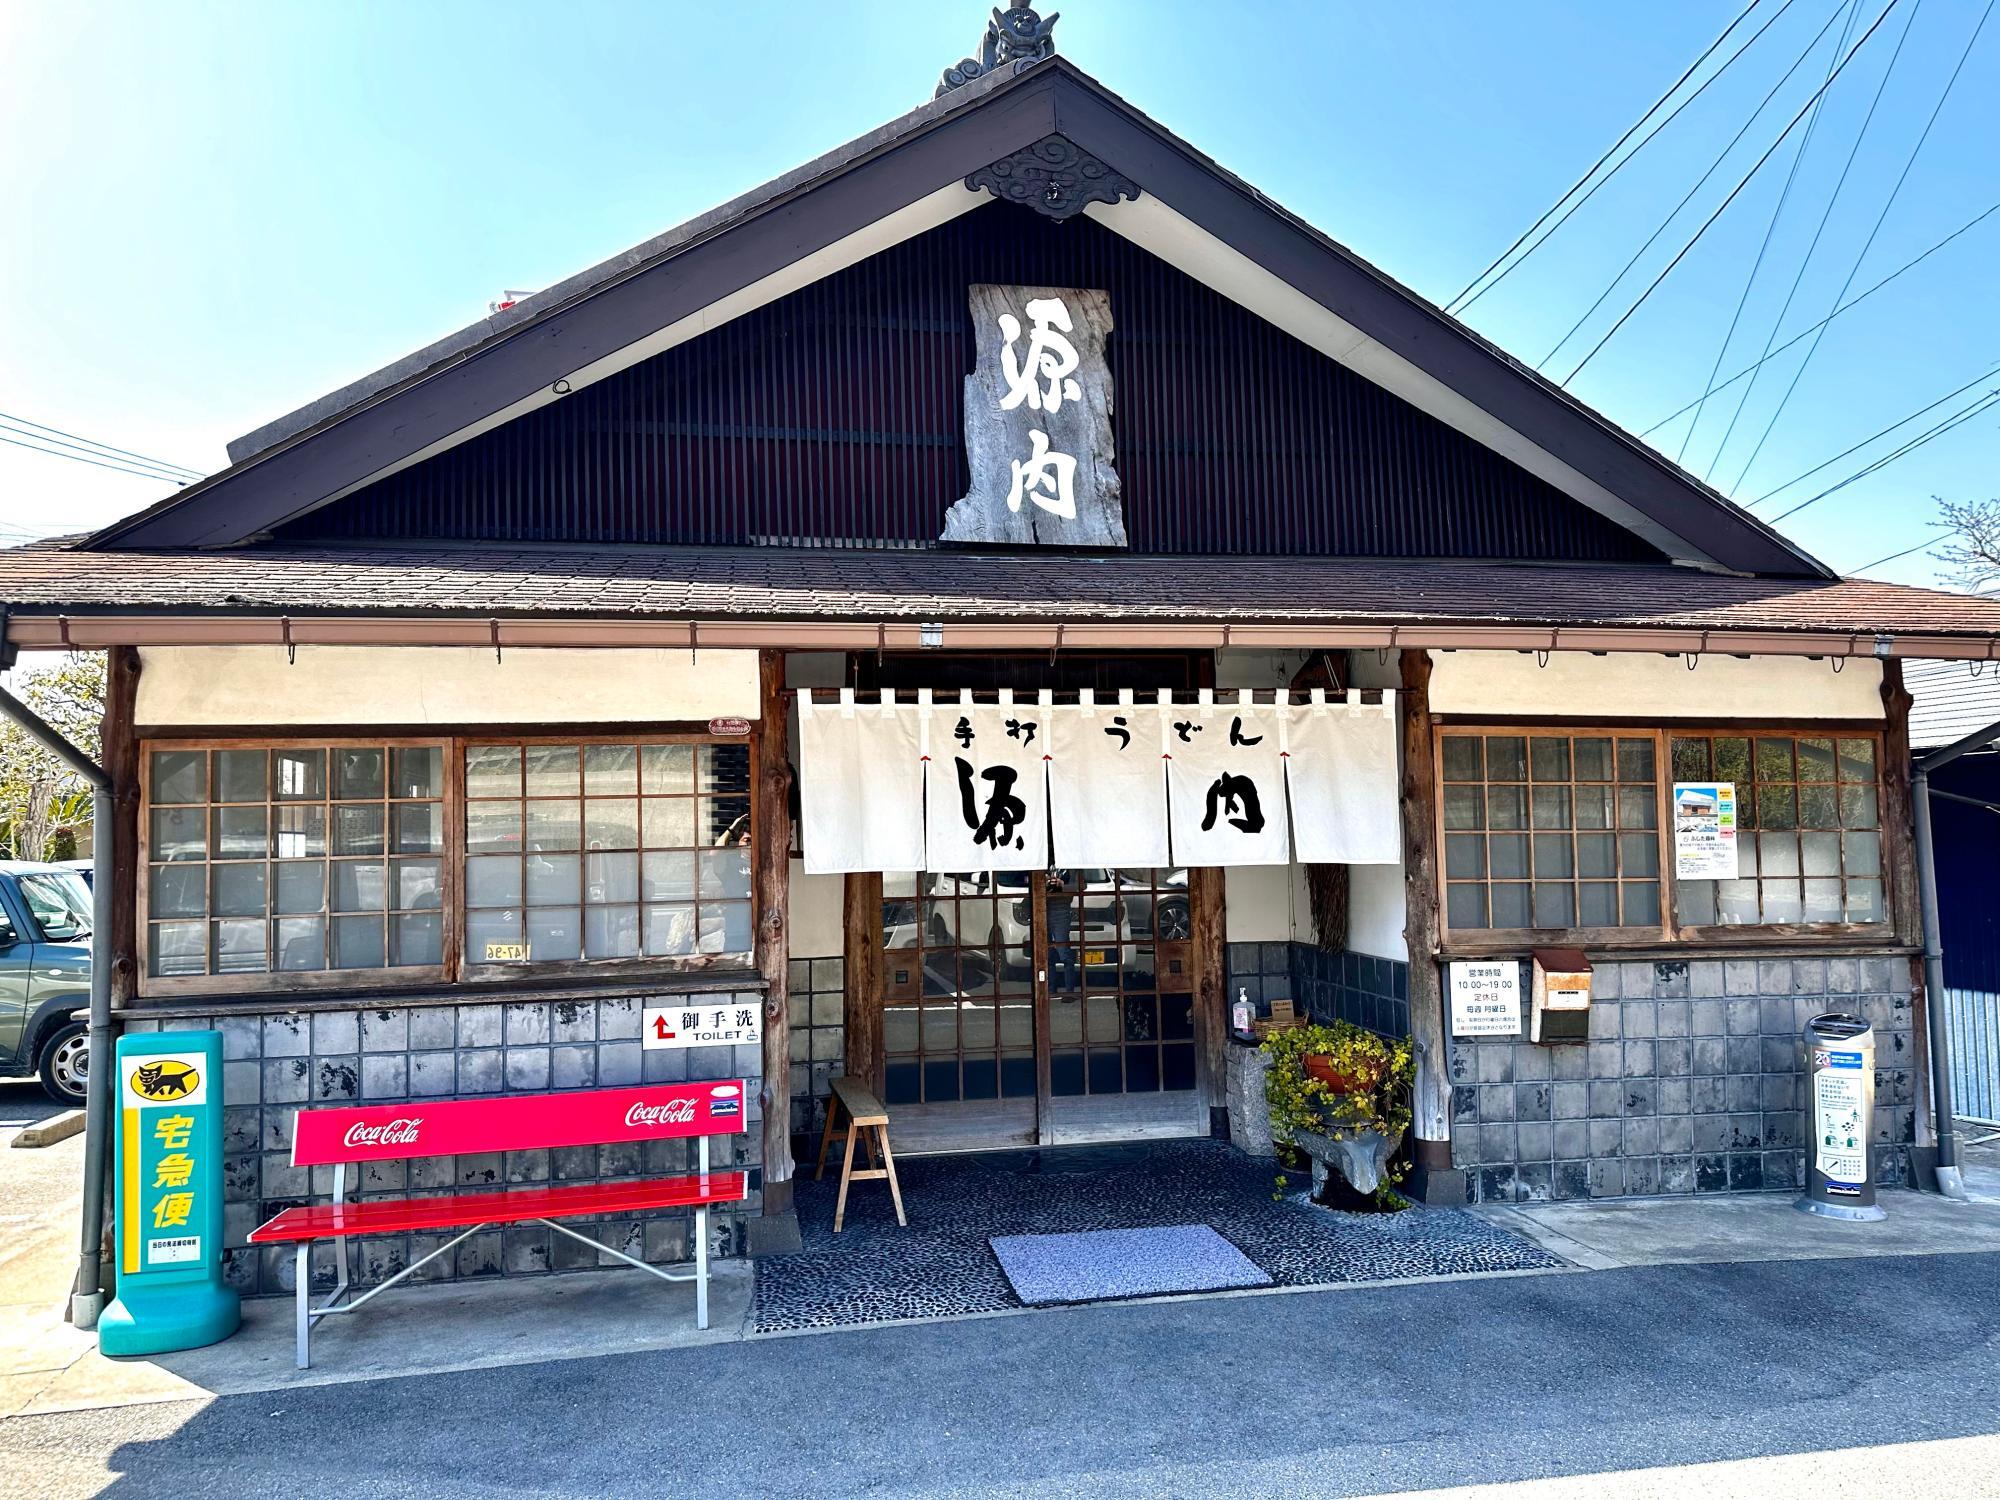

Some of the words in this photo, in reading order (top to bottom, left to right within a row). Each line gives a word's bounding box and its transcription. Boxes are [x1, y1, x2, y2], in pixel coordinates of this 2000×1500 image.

[998, 298, 1081, 519] 源内
[954, 716, 1263, 750] 手打うどん
[955, 757, 1265, 850] 源内
[1469, 969, 1502, 977] 営業時間
[1474, 993, 1498, 1001] 定休日
[682, 1010, 753, 1030] 御手洗
[693, 1031, 741, 1041] TOILET
[625, 1098, 699, 1126] Coca-Cola
[344, 1119, 424, 1147] Coca-Cola
[152, 1114, 195, 1228] 宅急便
